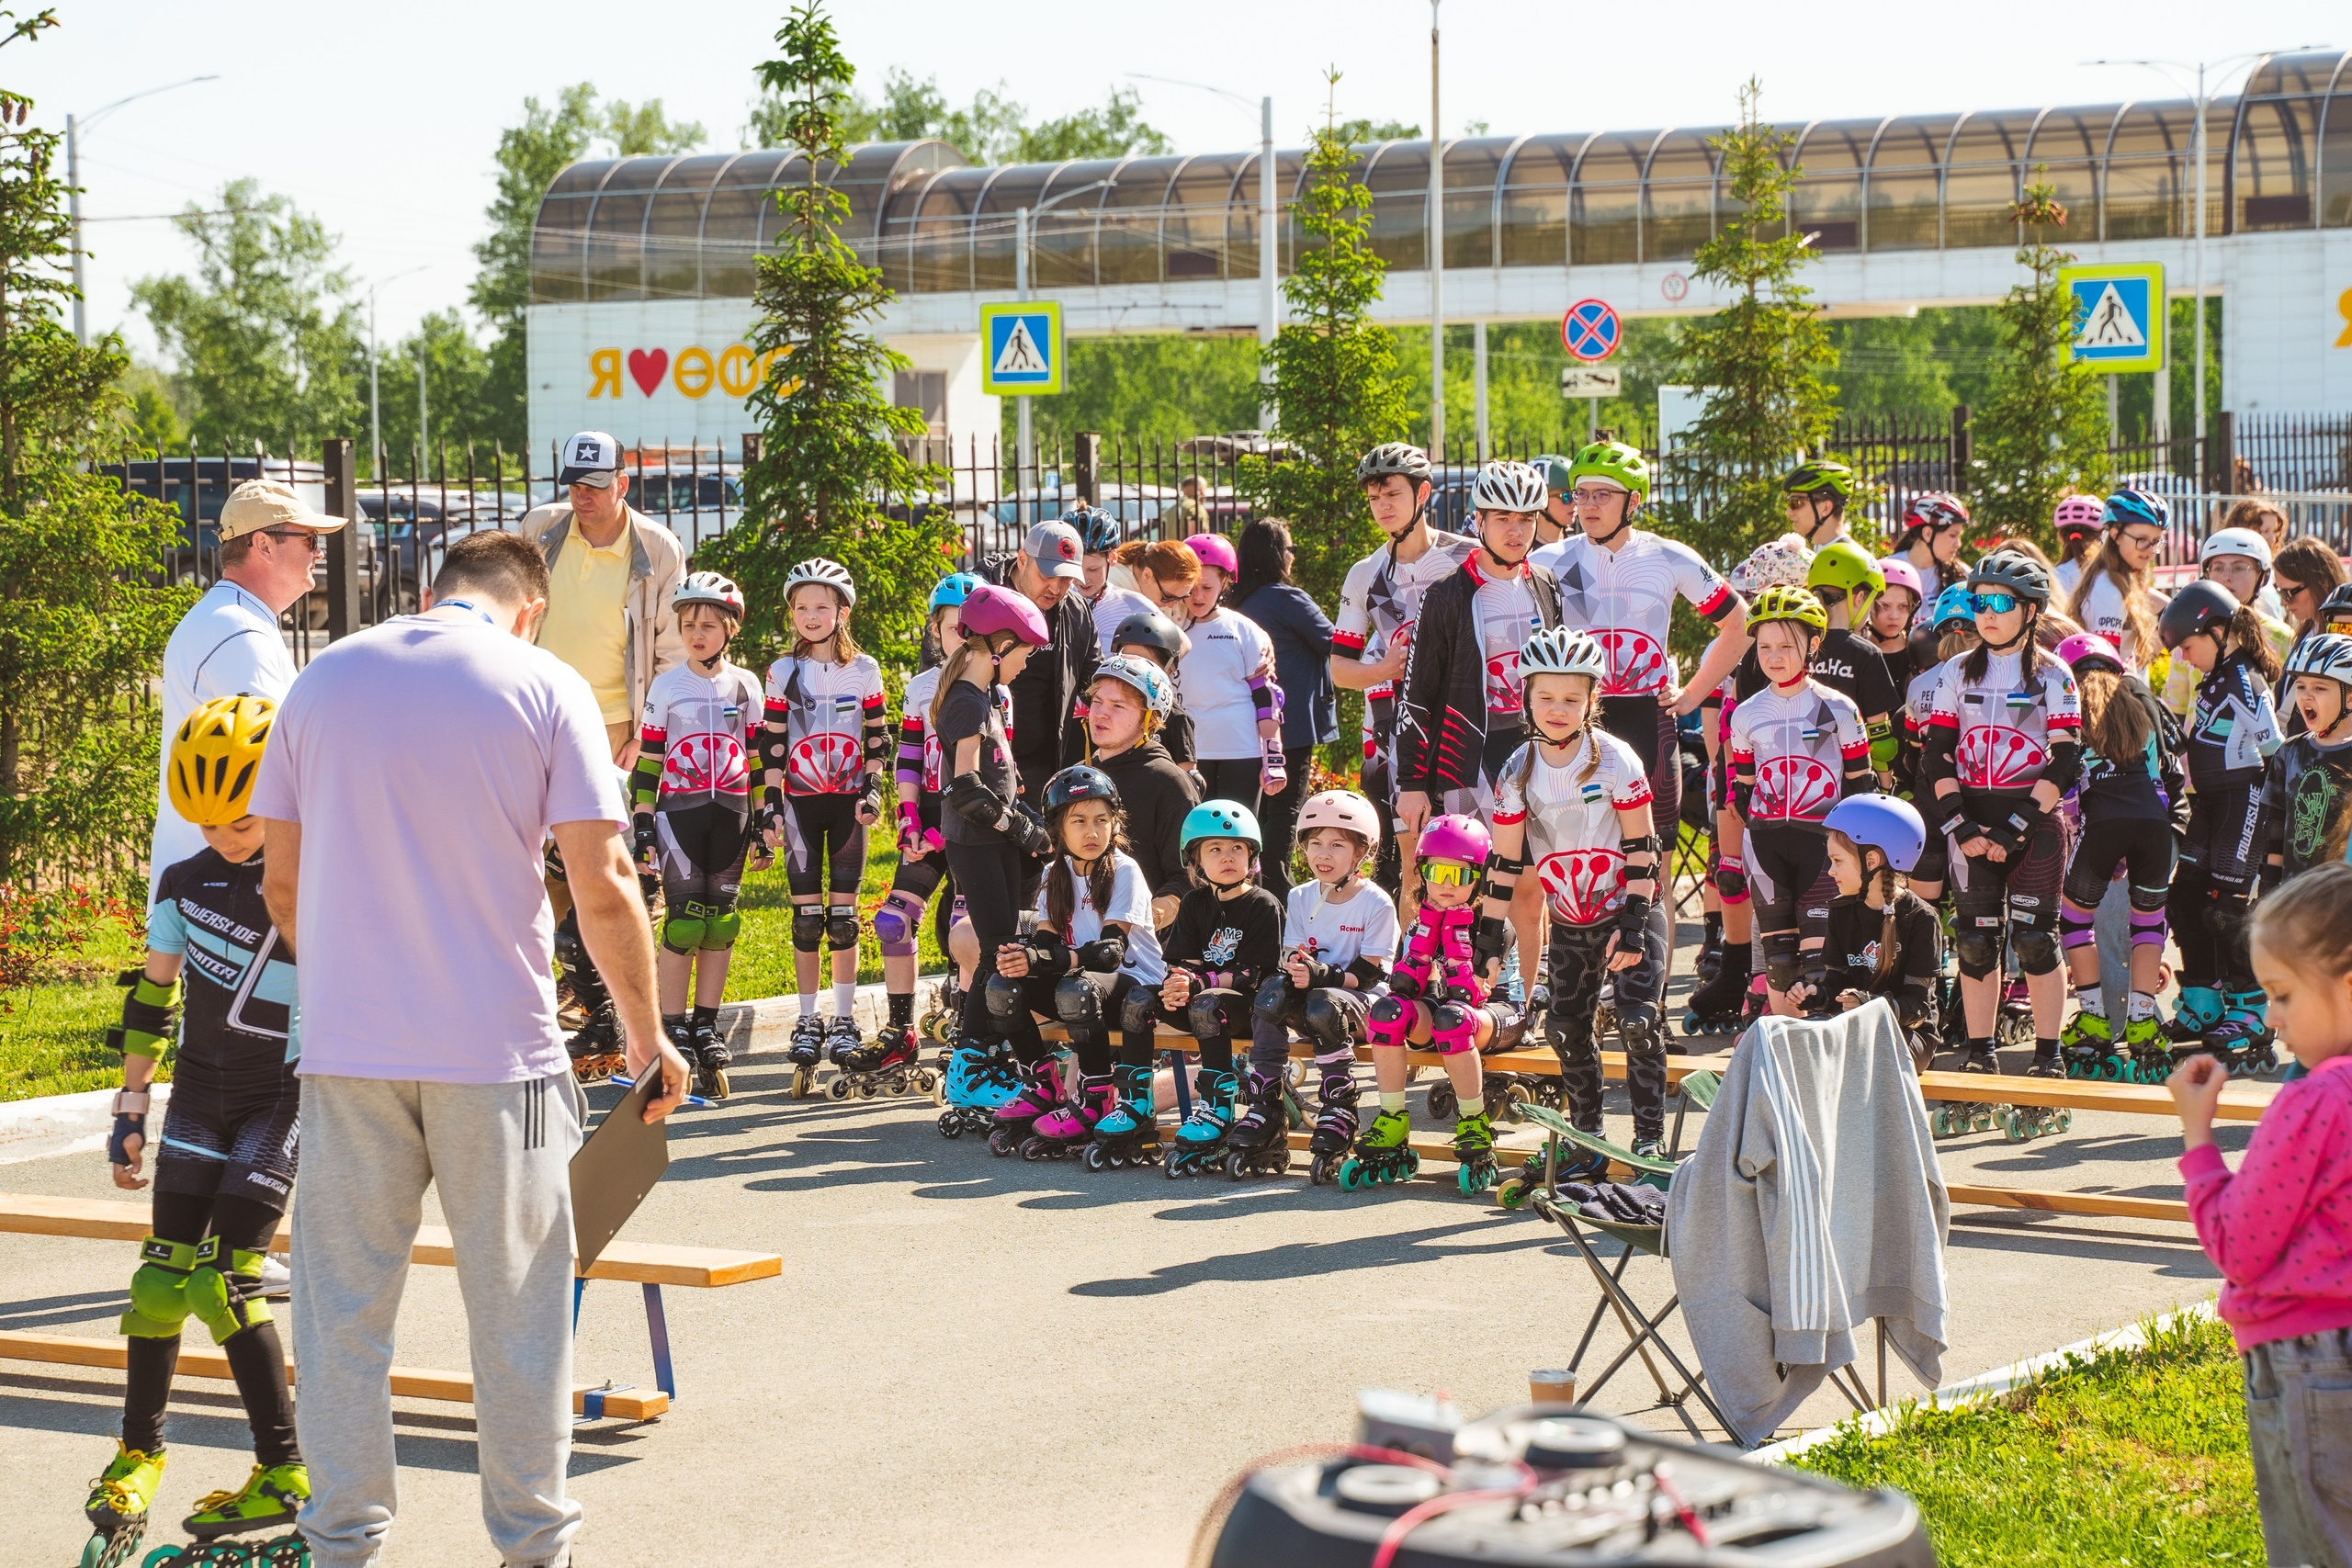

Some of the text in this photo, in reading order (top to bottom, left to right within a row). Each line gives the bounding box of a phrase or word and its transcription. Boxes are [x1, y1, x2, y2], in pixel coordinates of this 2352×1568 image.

[588, 348, 622, 399] Я
[1402, 642, 1416, 701] FLYING
[2235, 783, 2261, 863] POWERSLIDE
[187, 942, 239, 980] MATTER
